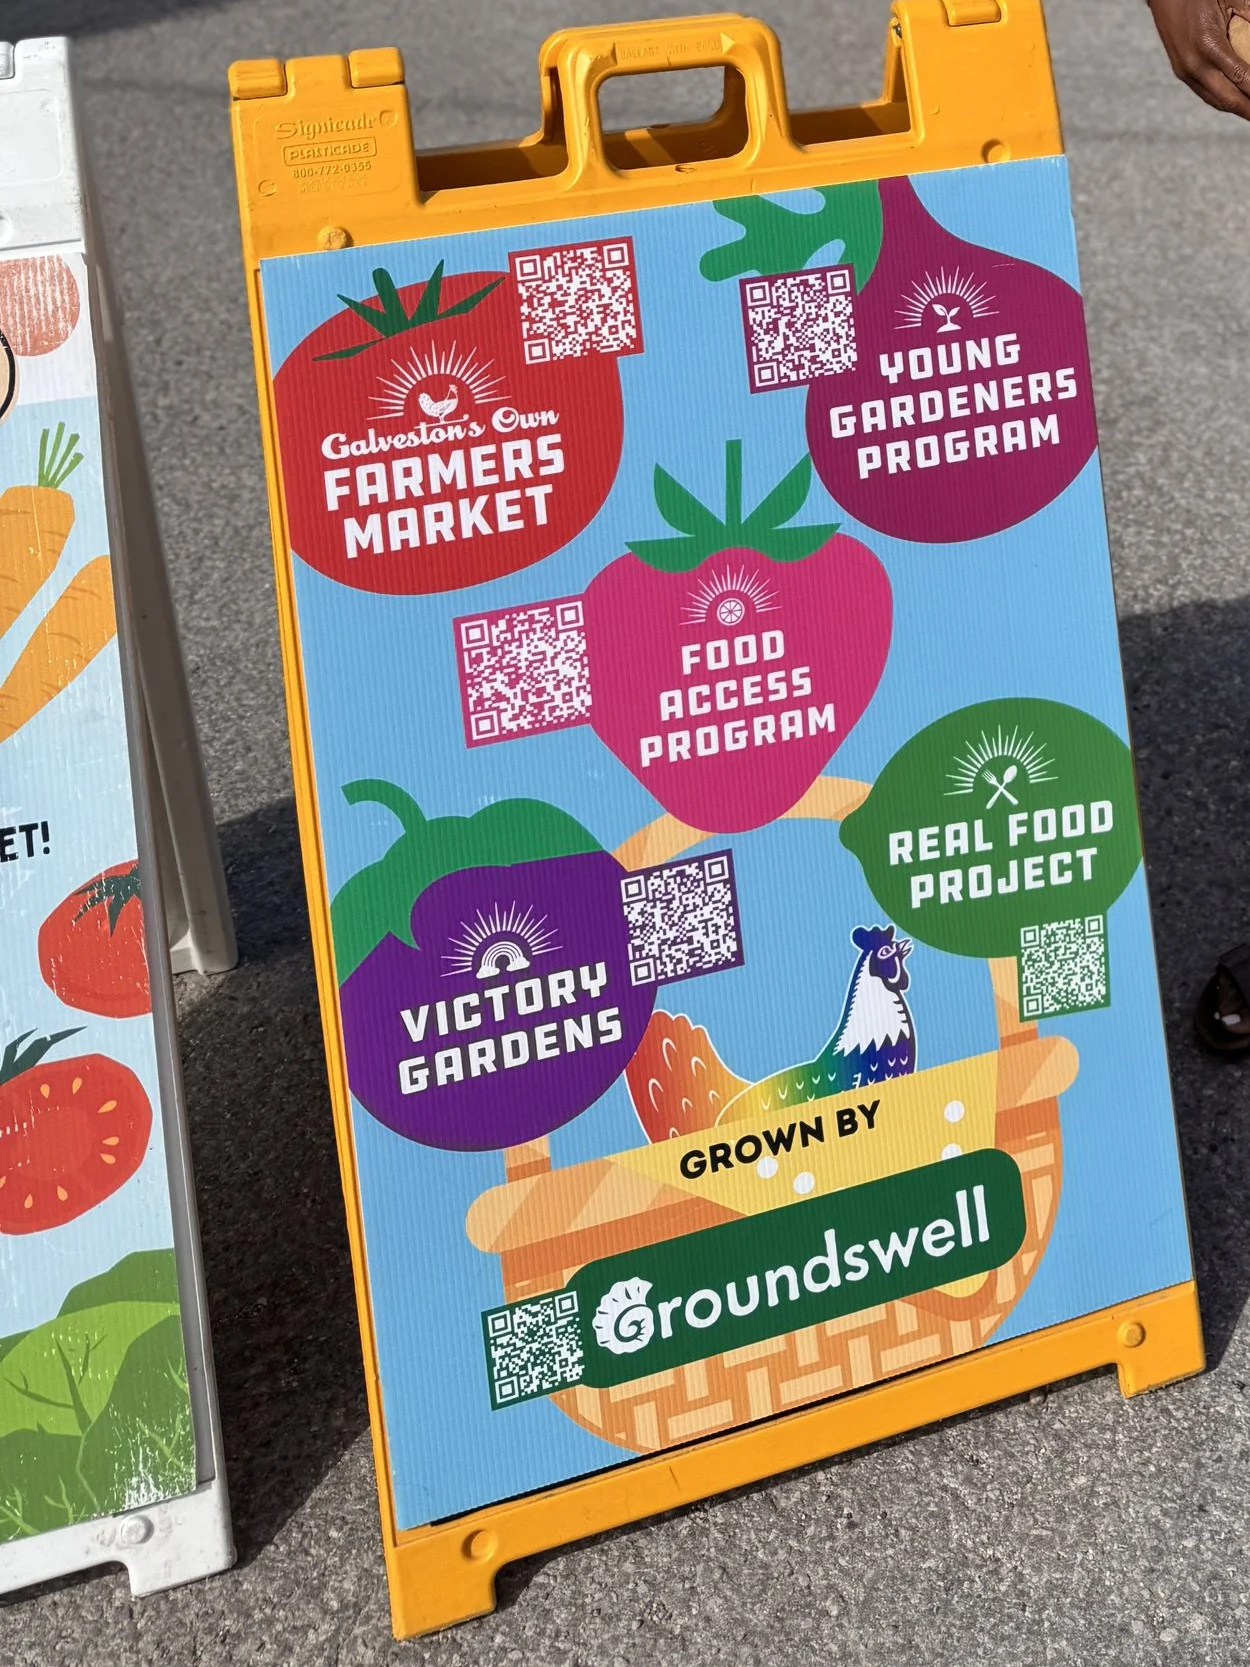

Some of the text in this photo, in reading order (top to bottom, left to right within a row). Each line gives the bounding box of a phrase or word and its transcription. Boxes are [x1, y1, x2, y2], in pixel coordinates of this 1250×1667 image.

[274, 112, 377, 140] Signicade
[289, 142, 370, 161] PLASTICADE
[293, 161, 372, 179] 800-772-0355
[879, 333, 1020, 384] YOUNG
[321, 406, 560, 460] Galveston's Own
[829, 367, 1077, 439] GARDENERS
[324, 434, 565, 512] FARMERS
[857, 414, 1060, 479] PROGRAM
[343, 484, 553, 559] MARKET
[681, 629, 785, 675] FOOD
[659, 665, 812, 721] ACCESS
[640, 703, 836, 767] PROGRAM
[889, 800, 1114, 866] REAL FOOD
[910, 847, 1098, 909] PROJECT
[400, 961, 607, 1043] VICTORY
[398, 1007, 622, 1095] GARDENS
[679, 1099, 881, 1180] GROWN BY
[592, 1184, 991, 1355] Groundswell
